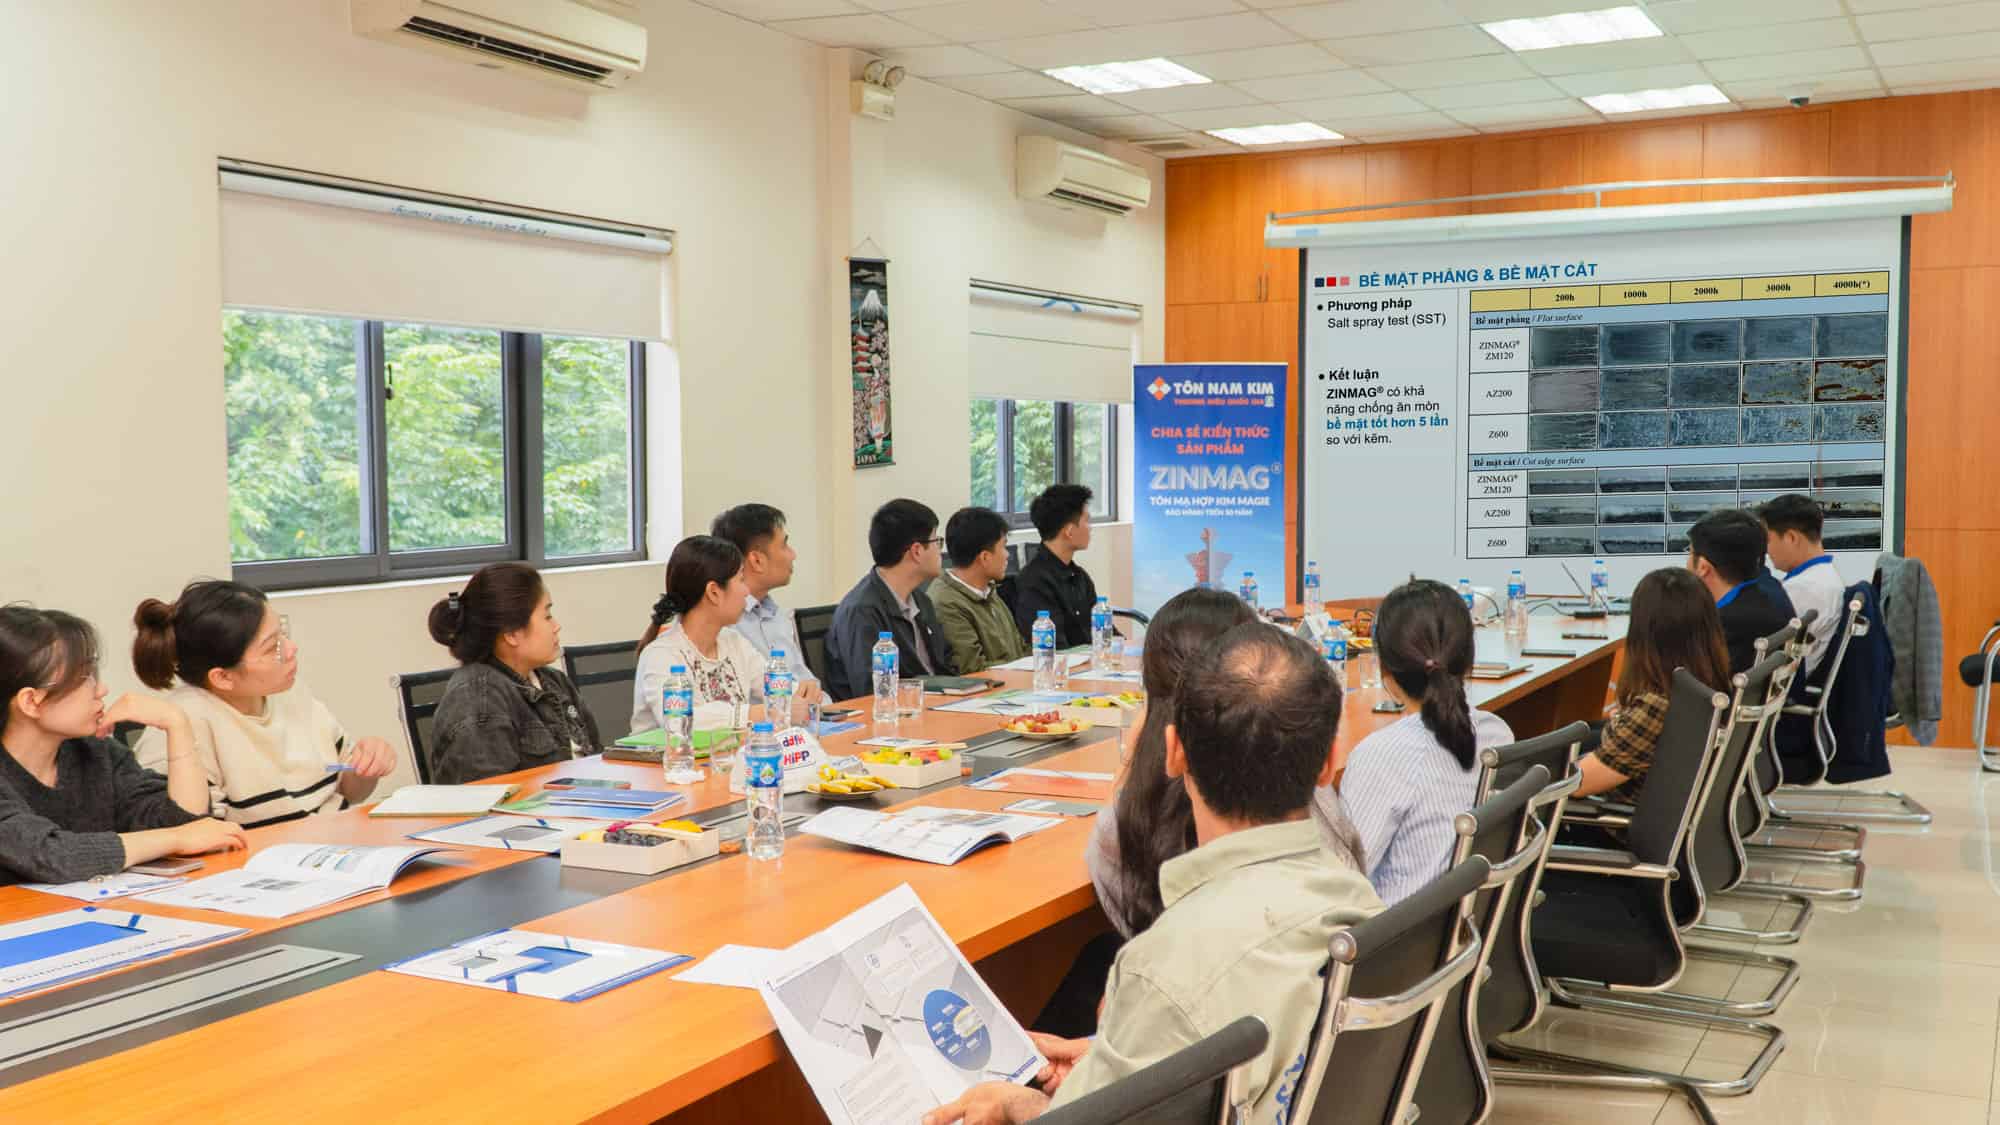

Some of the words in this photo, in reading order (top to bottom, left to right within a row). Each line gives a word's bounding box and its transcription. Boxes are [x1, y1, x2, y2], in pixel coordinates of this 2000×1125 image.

[1483, 268, 1494, 281] &
[1693, 287, 1719, 296] 2000h
[1765, 284, 1791, 292] 3000h
[1555, 293, 1574, 302] 200h
[1623, 290, 1648, 299] 1000h
[1327, 300, 1378, 312] Phương
[1381, 297, 1413, 311] pháp
[1327, 317, 1350, 328] Salt
[1352, 318, 1385, 330] spray
[1387, 315, 1409, 326] test
[1412, 312, 1447, 327] (SST)
[1537, 314, 1552, 322] Flat
[1554, 313, 1584, 322] surface
[1485, 352, 1514, 360] ZM120
[1329, 367, 1349, 380] Kết
[1353, 369, 1379, 382] luận
[1173, 380, 1204, 395] TÔN
[1207, 383, 1243, 395] NAM
[1247, 383, 1274, 395] KIM
[1386, 386, 1401, 397] có
[1403, 385, 1425, 397] khả
[1486, 389, 1513, 398] AZ200
[1326, 404, 1355, 416] năng
[1358, 400, 1393, 415] chống
[1344, 417, 1368, 431] mặt
[1371, 415, 1388, 429] tốt
[1391, 417, 1416, 428] hơn
[1418, 417, 1427, 426] 5
[1430, 413, 1449, 427] lần
[1151, 427, 1183, 438] CHIA
[1235, 424, 1270, 438] THỨC
[1488, 430, 1509, 439] Z600
[1326, 436, 1340, 445] so
[1343, 433, 1361, 444] với
[1364, 433, 1392, 444] kẽm.
[1522, 458, 1537, 466] Cut
[1556, 456, 1586, 467] surface
[1483, 486, 1512, 494] ZM120
[1151, 495, 1172, 506] TÔN
[1216, 496, 1235, 506] KIM
[1484, 508, 1511, 518] AZ200
[1487, 539, 1507, 547] Z600
[783, 750, 809, 767] HiPP
